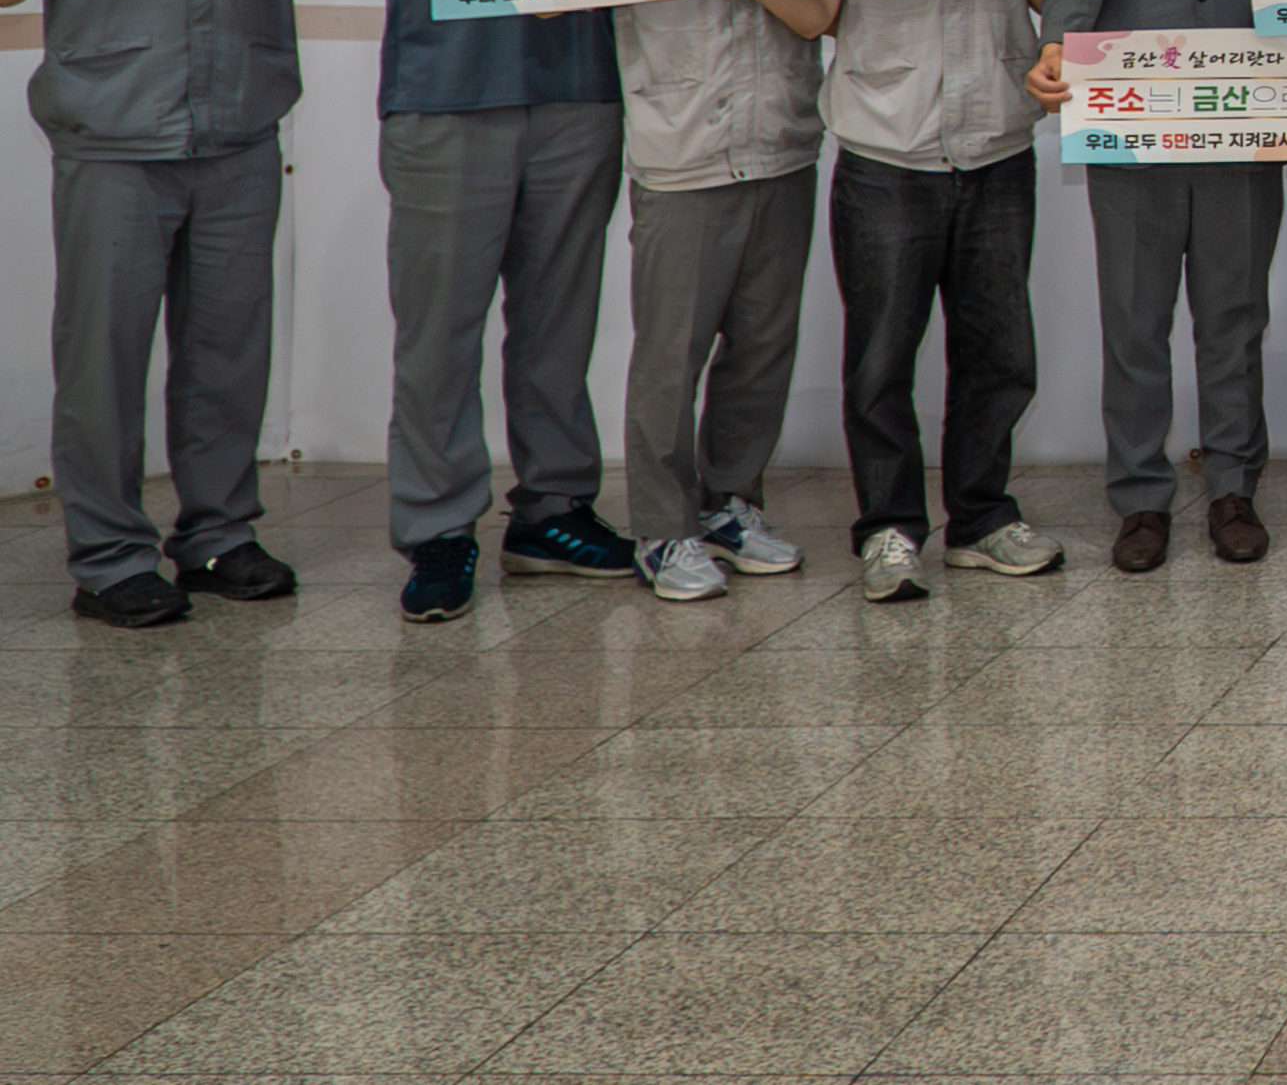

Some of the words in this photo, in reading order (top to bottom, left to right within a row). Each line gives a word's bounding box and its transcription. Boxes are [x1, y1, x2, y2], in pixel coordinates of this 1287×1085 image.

[1188, 50, 1284, 68] 살어리랏다
[1086, 86, 1181, 113] 주소는!
[1086, 133, 1118, 150] 우리
[1123, 133, 1157, 150] 모두
[1161, 132, 1222, 149] 5만인구
